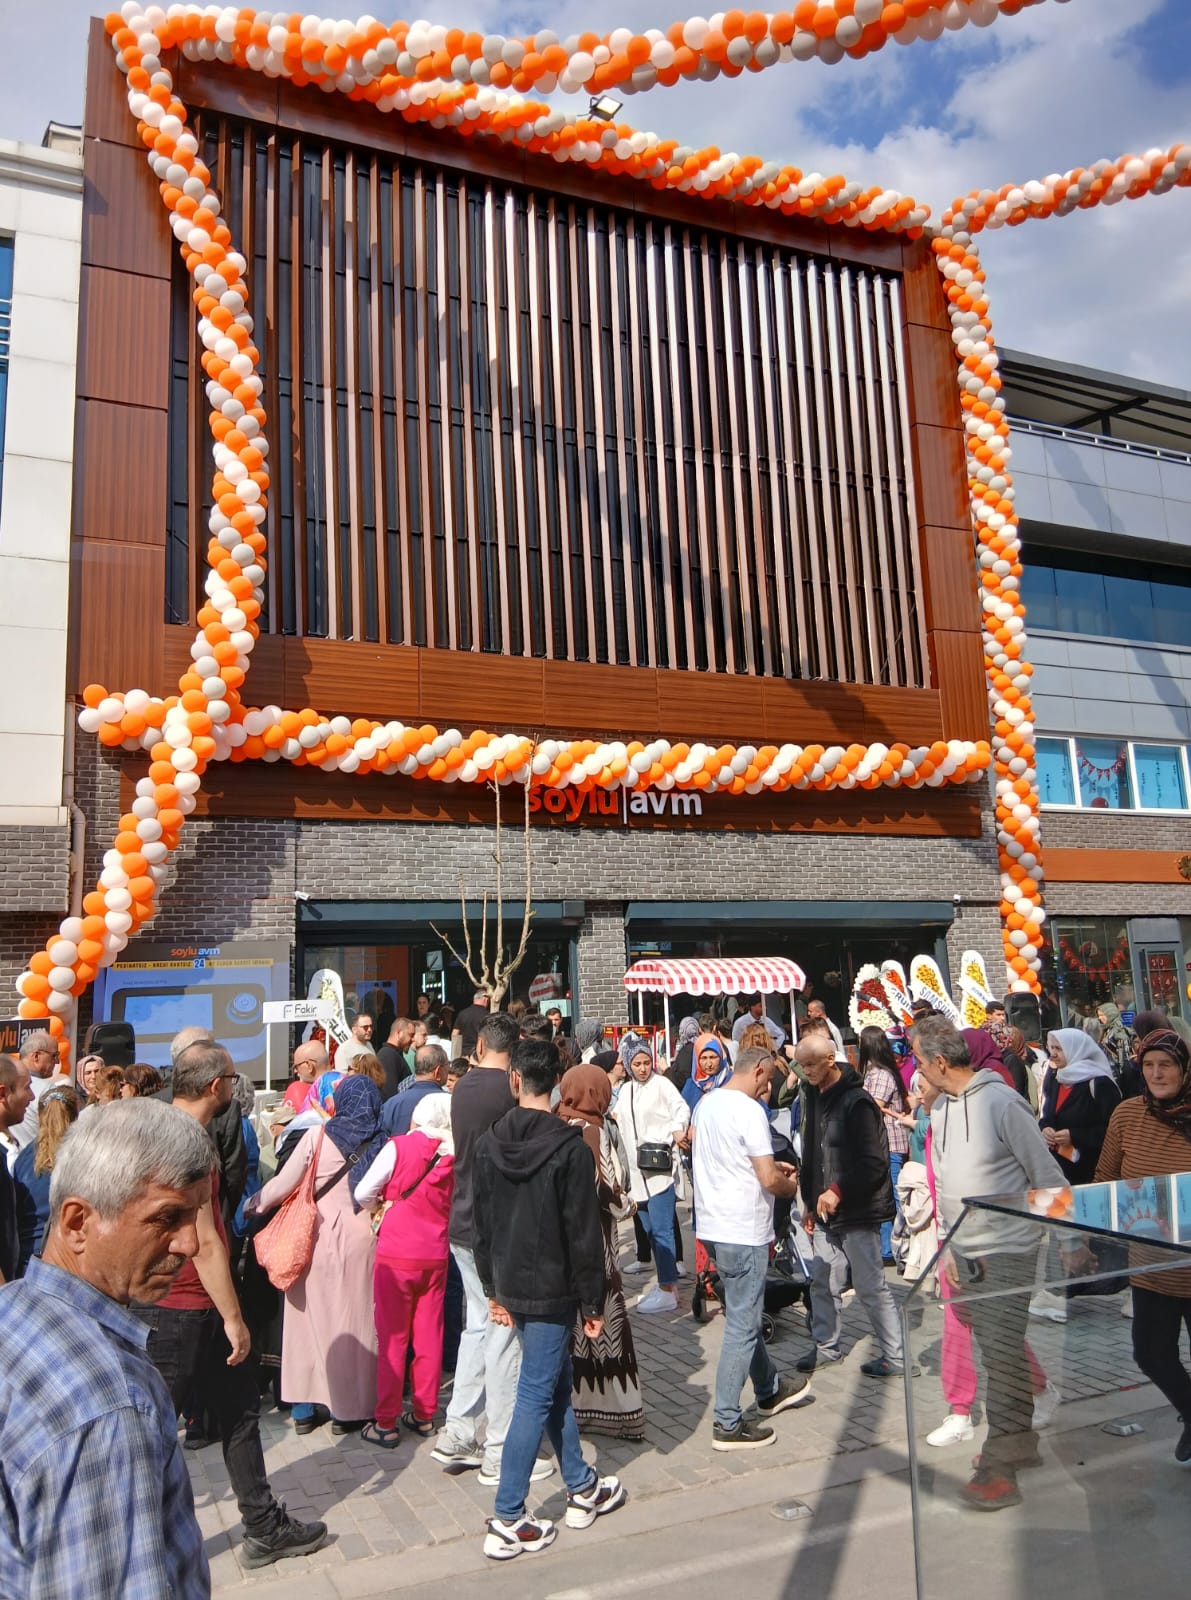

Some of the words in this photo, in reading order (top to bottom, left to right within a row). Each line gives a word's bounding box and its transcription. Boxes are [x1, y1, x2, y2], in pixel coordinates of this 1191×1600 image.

[528, 785, 619, 822] soylu
[629, 790, 703, 816] avm
[170, 946, 197, 958] soylu
[198, 947, 220, 956] avm
[194, 959, 205, 969] 24
[294, 1003, 318, 1014] Fakir
[0, 1025, 17, 1052] ylu
